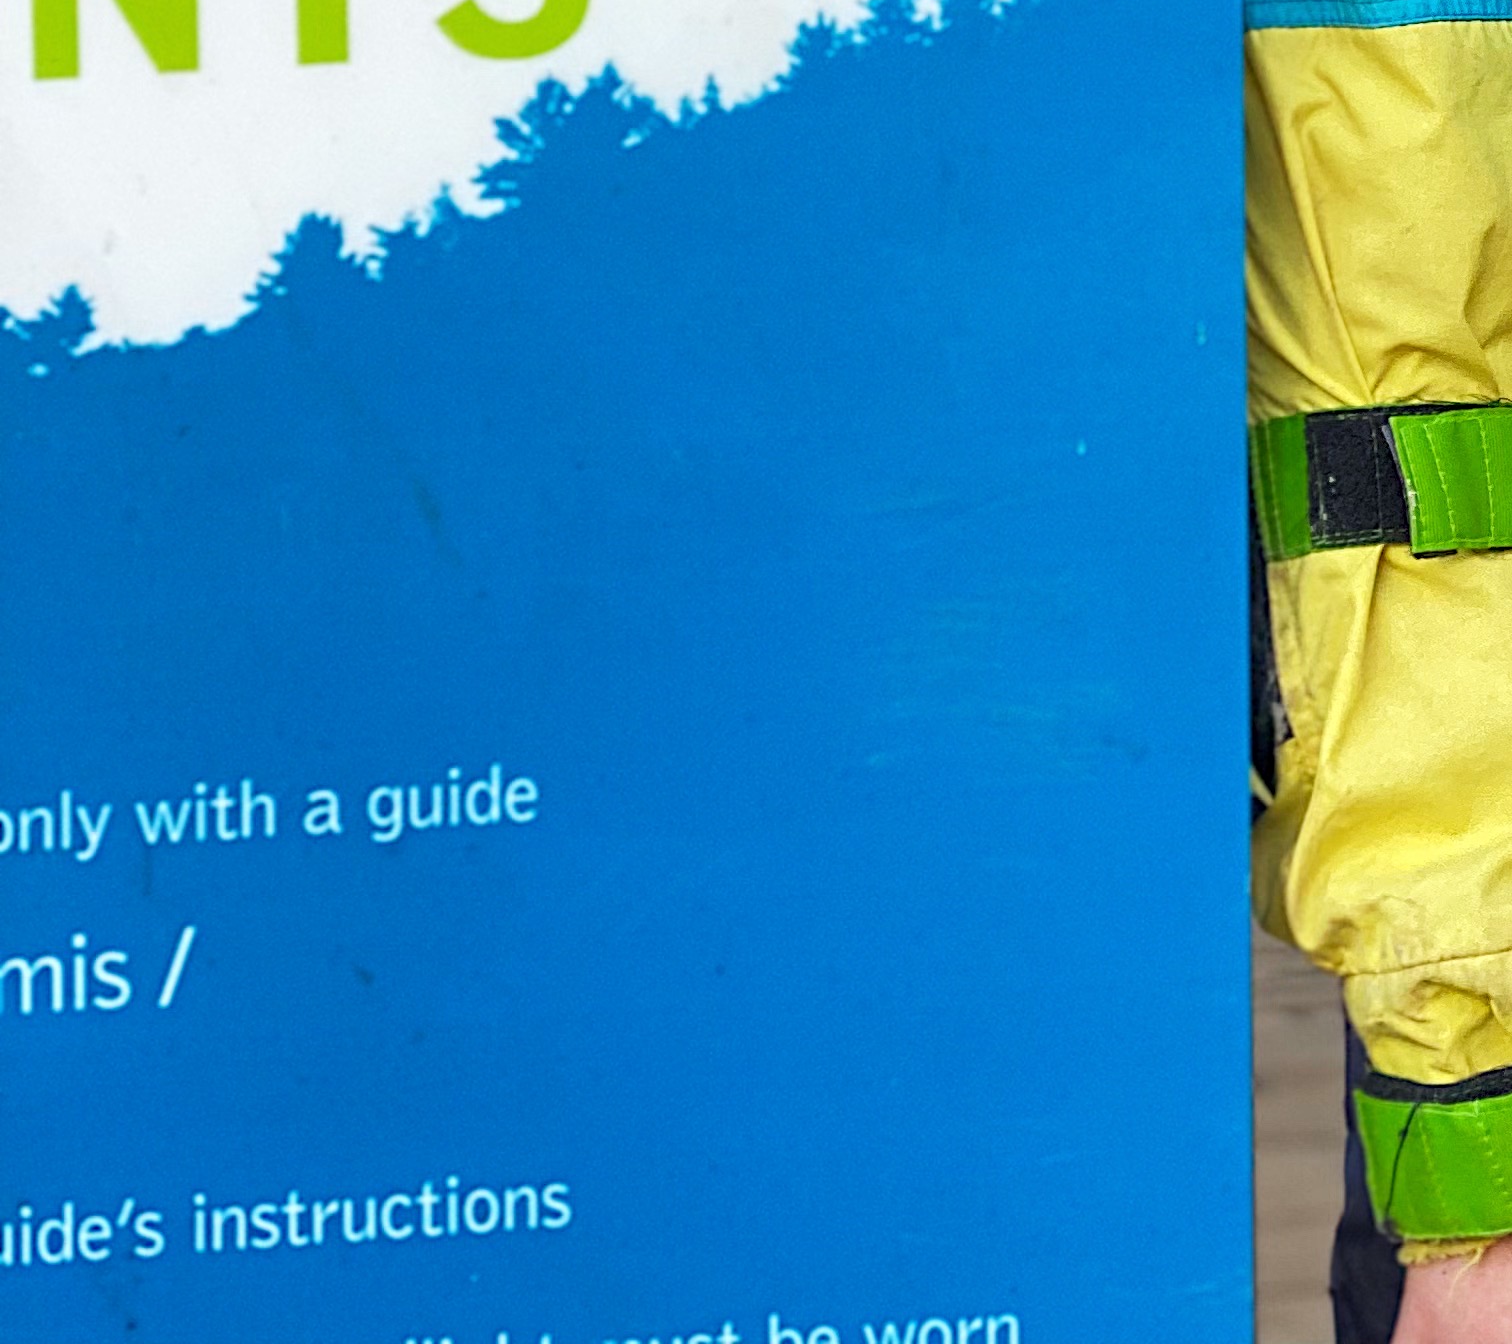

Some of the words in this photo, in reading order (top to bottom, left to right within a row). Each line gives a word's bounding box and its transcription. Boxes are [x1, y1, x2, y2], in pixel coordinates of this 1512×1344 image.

[136, 779, 276, 844] with
[304, 789, 342, 835] a
[367, 764, 538, 843] guide
[159, 925, 195, 1008] /
[194, 1176, 571, 1252] instructions
